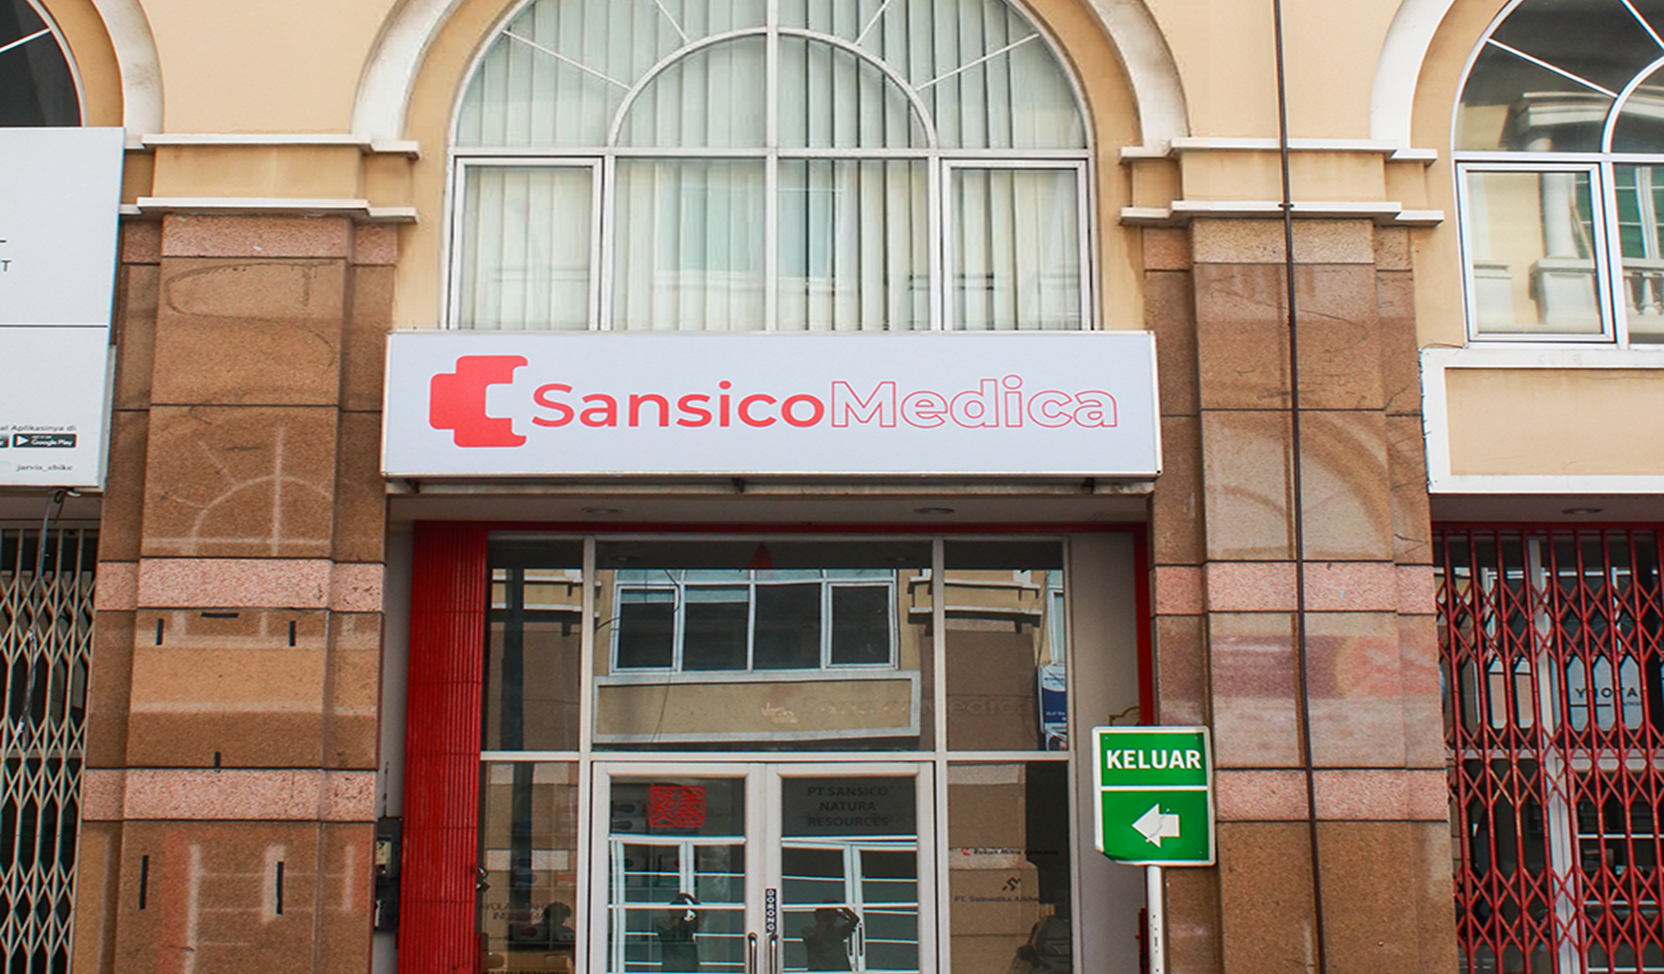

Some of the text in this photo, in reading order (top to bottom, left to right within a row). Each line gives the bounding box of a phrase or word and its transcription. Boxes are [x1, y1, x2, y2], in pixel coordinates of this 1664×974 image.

[531, 374, 1118, 428] SansicoMedica
[1106, 749, 1202, 769] KELUAR
[807, 786, 889, 797] PT SANSICO
[819, 801, 877, 812] NATURA
[807, 816, 889, 827] RESOURCES
